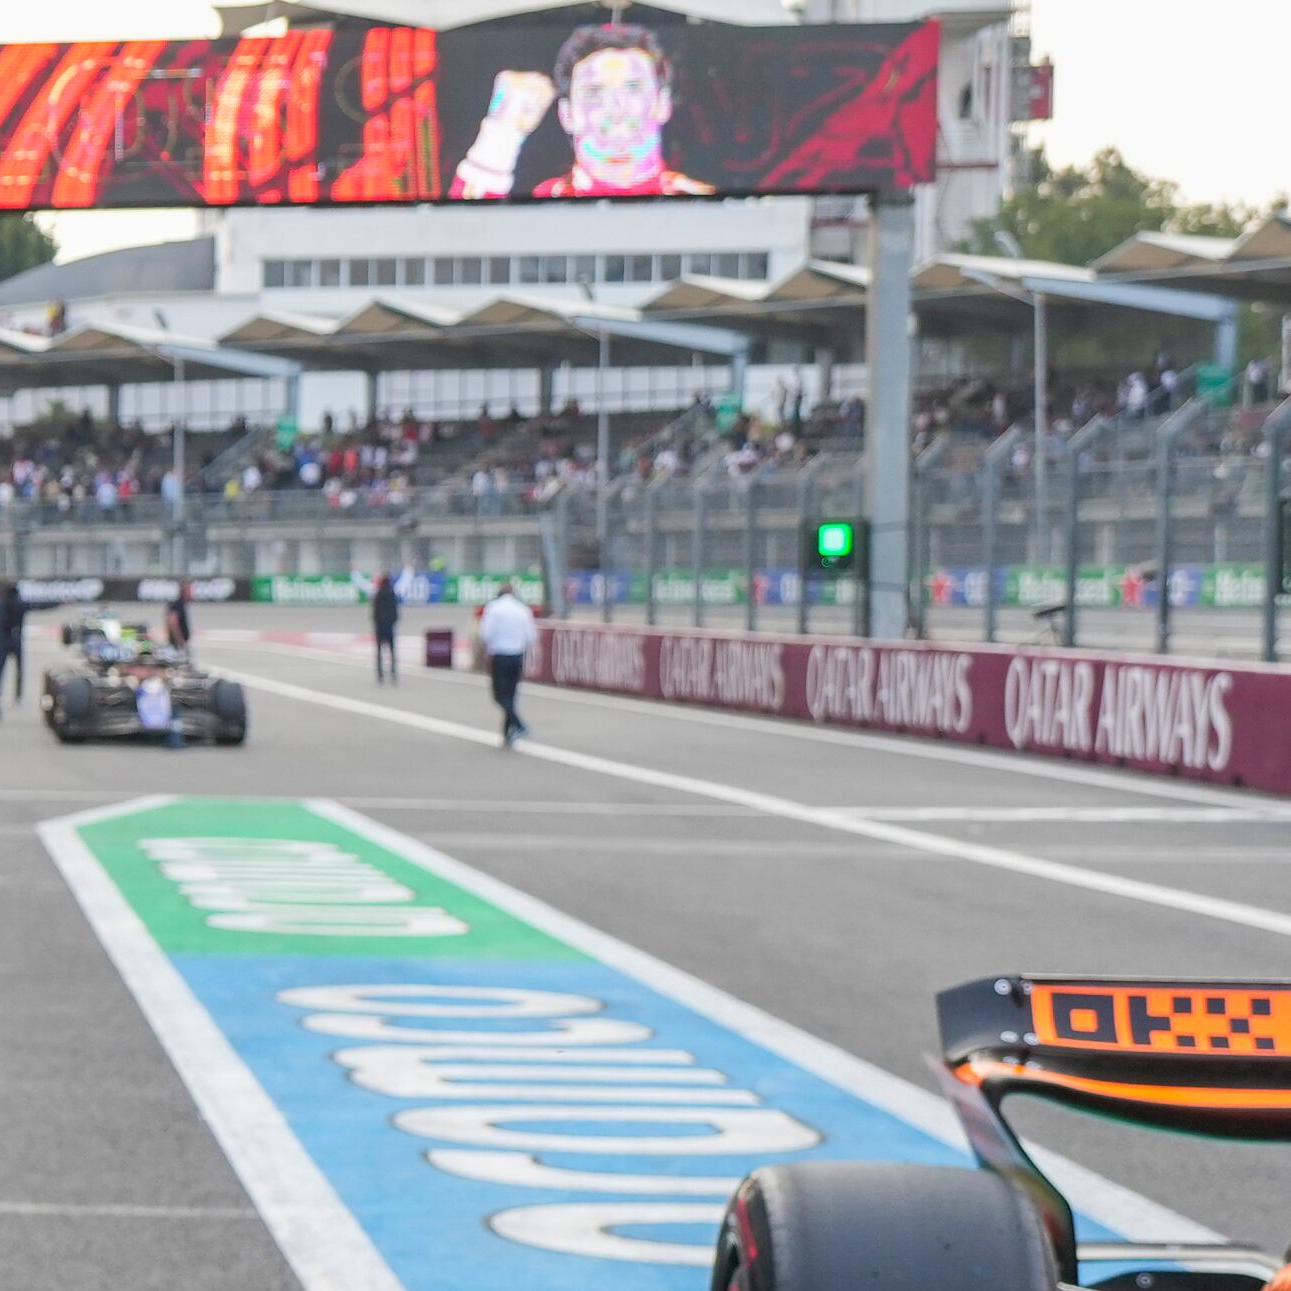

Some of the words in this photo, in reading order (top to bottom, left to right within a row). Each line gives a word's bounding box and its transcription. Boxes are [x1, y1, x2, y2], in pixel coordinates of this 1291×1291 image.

[660, 635, 716, 700] QATAR
[715, 637, 785, 711] AIRWAYS
[806, 645, 874, 721] QATAR
[875, 650, 974, 735] AIRWAYS
[1004, 656, 1094, 750] QATAR
[1095, 662, 1234, 772] AIRWAYS
